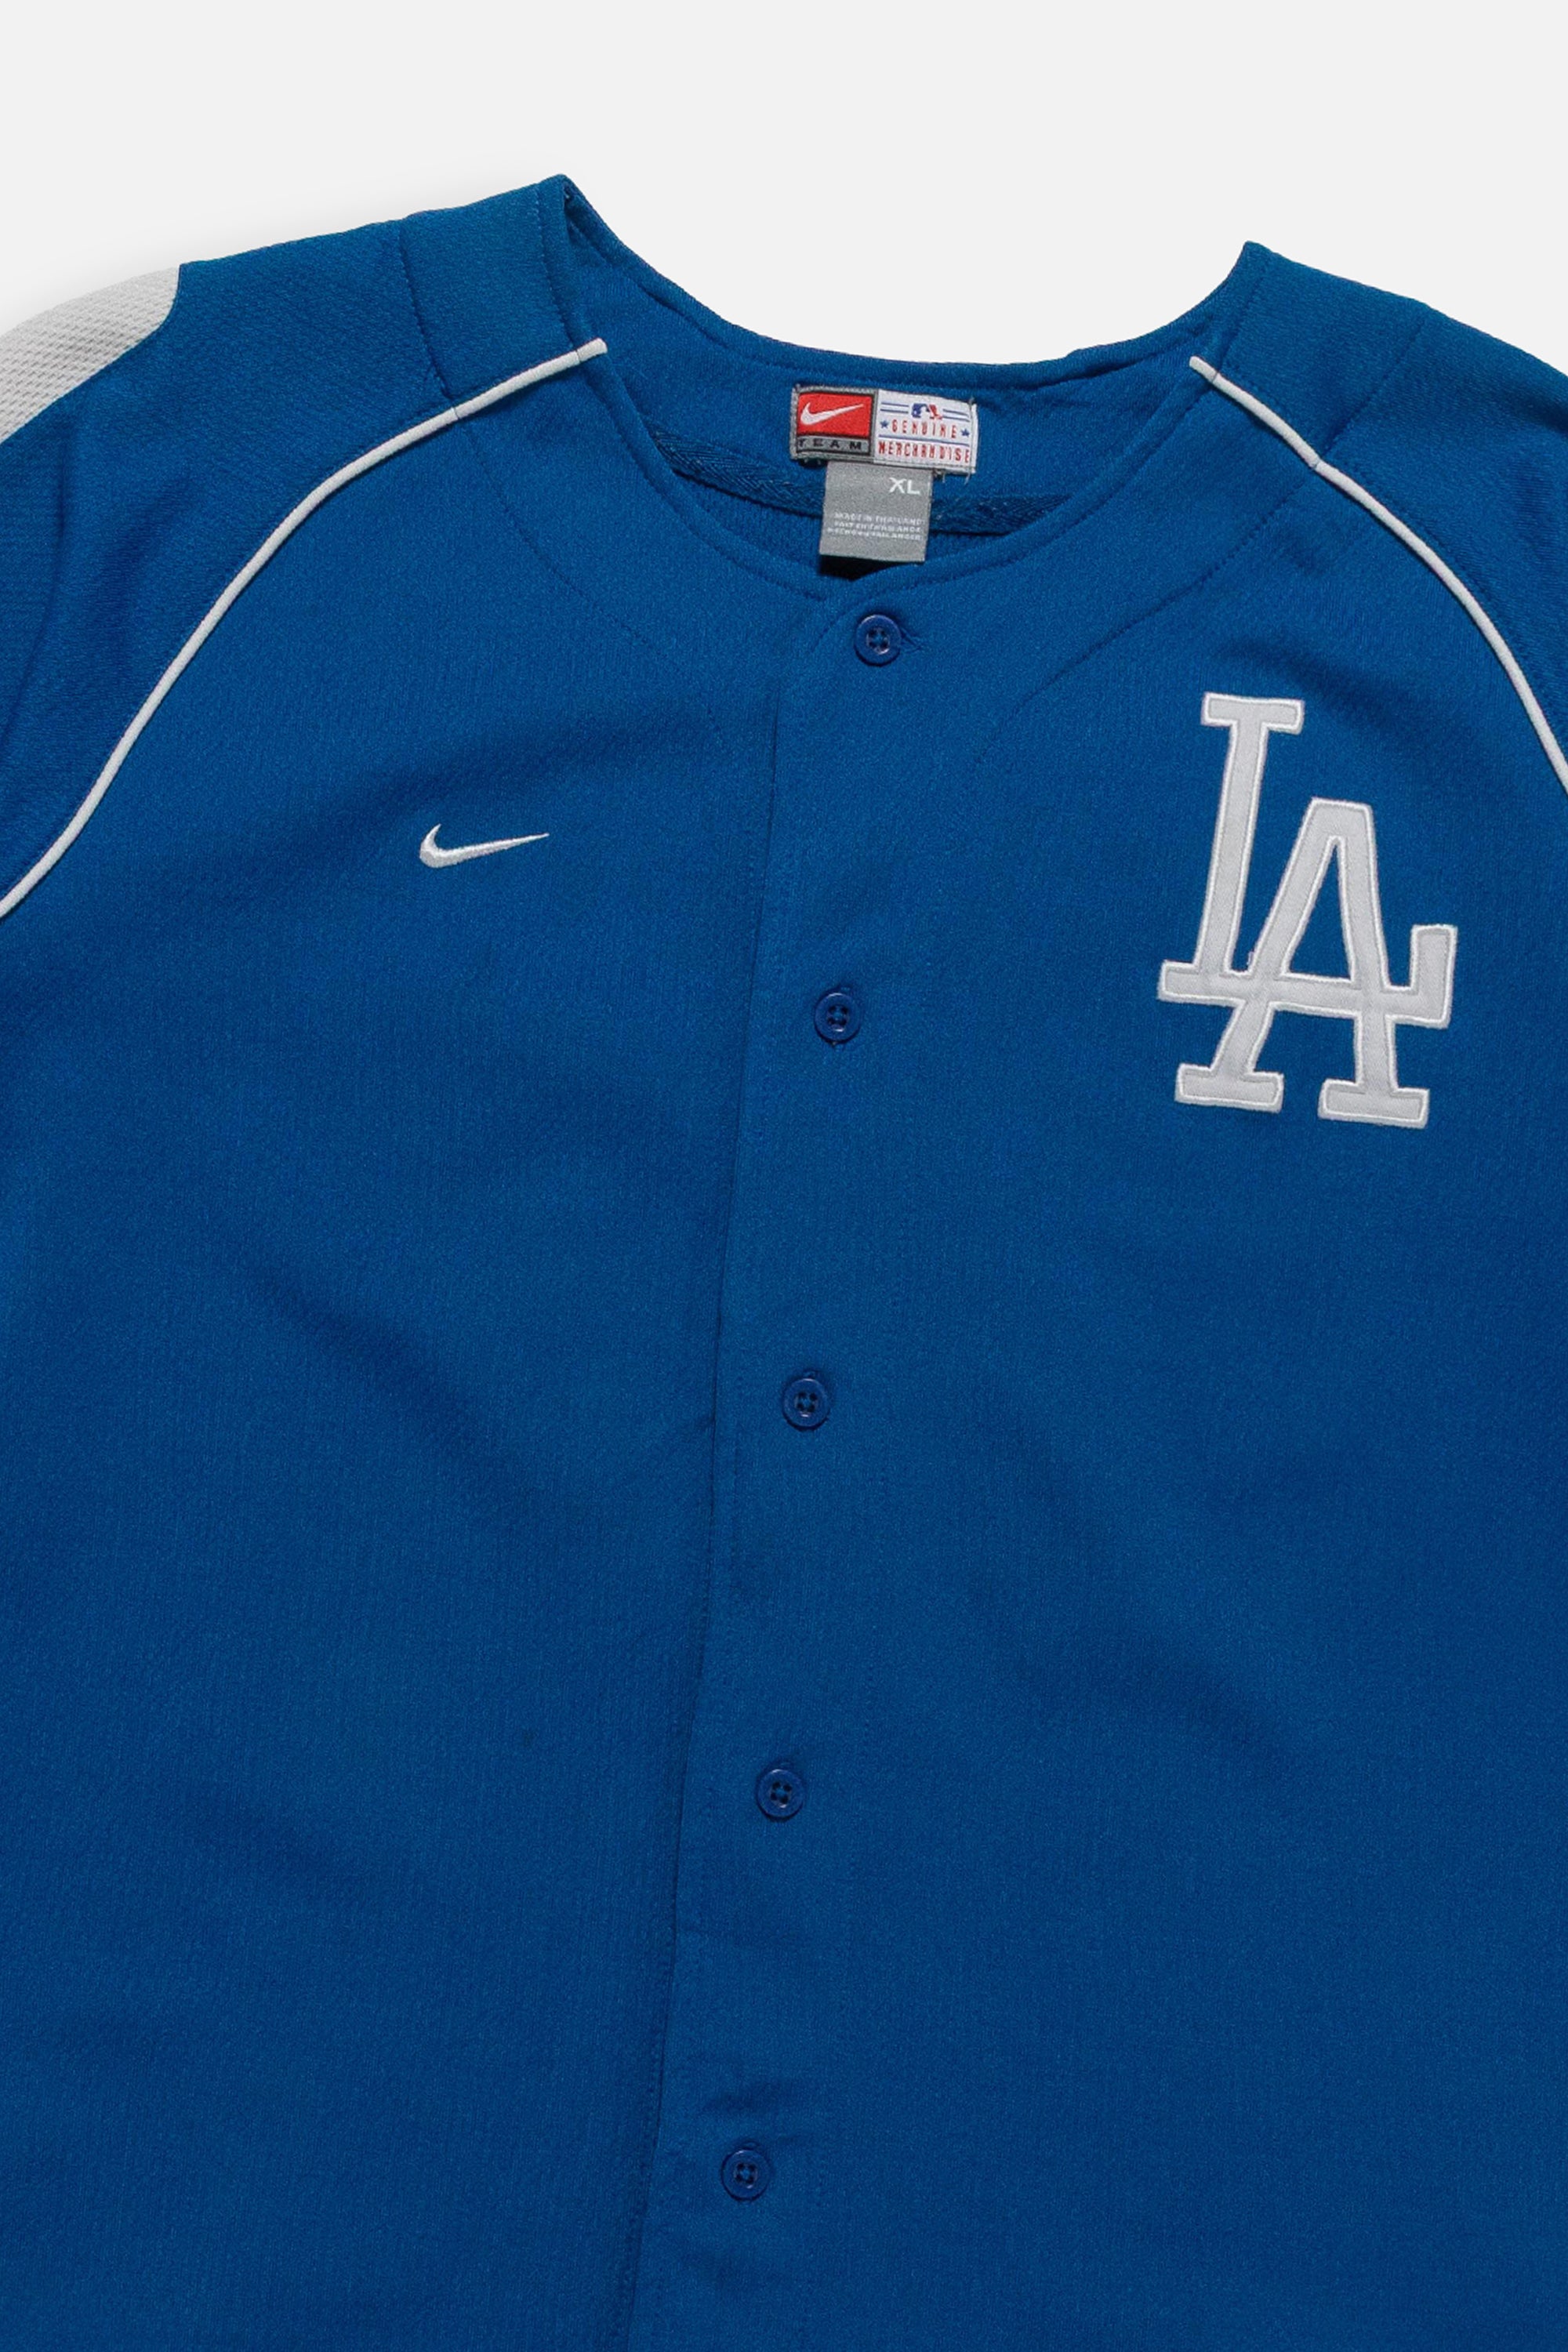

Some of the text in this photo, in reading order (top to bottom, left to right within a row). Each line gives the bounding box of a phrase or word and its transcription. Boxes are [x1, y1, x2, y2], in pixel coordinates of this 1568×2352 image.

[891, 419, 957, 438] GENUINE
[797, 437, 862, 451] TEAM
[878, 441, 971, 463] MERCHANDISE
[888, 477, 920, 495] XL
[1156, 691, 1458, 1129] LA
